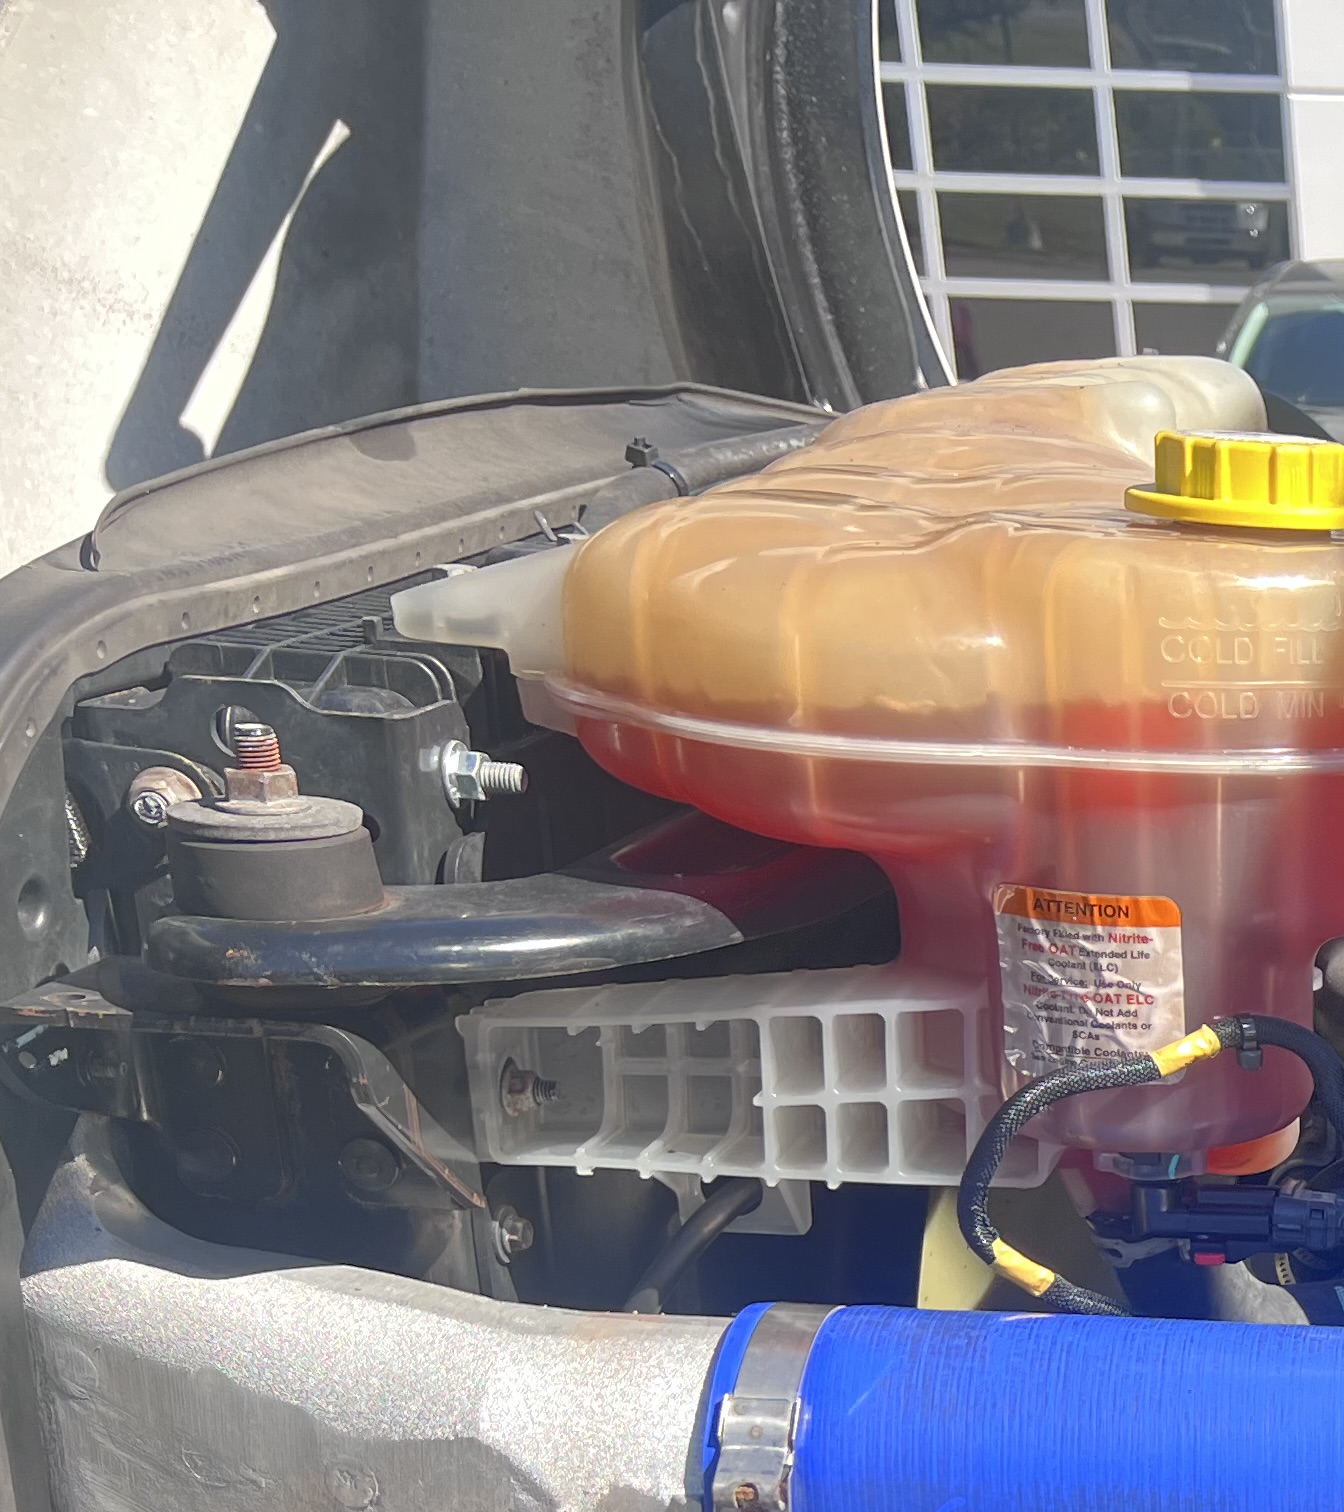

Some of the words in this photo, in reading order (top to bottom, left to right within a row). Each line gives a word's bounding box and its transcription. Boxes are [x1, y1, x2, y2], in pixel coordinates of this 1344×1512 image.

[1160, 635, 1254, 665] COLD
[1273, 636, 1325, 665] FILL
[1167, 691, 1260, 719] COLD
[1277, 690, 1325, 719] MIN
[1033, 898, 1130, 919] ATTENTION
[1107, 932, 1154, 944] Nitrite-
[1050, 942, 1076, 956] OAT
[1078, 949, 1128, 960] Extended
[1130, 950, 1151, 961] Life
[1047, 957, 1087, 970] Coolant
[1092, 993, 1122, 1005] OAT
[1126, 994, 1155, 1006] ELC
[1095, 1007, 1114, 1017] Not
[1116, 1008, 1138, 1018] Add
